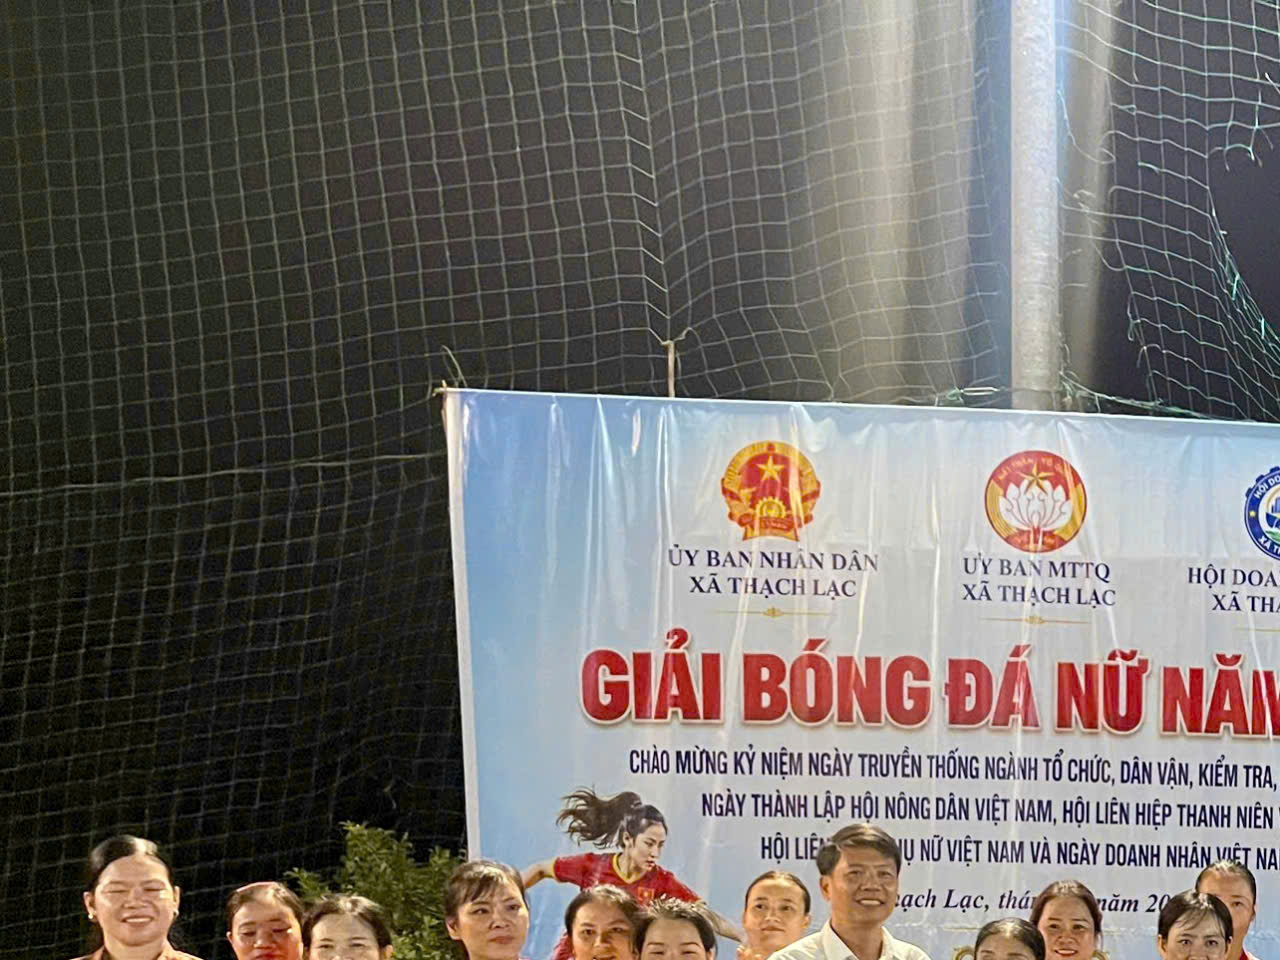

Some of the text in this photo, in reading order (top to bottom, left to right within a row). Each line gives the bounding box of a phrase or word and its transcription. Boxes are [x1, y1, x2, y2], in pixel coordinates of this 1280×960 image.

[668, 544, 879, 572] ỦY BAN NHÂN DÂN
[1000, 558, 1043, 577] BAN
[1049, 560, 1111, 584] MTTQ
[689, 573, 857, 600] XÃ THẠCH LẠC
[1187, 563, 1226, 588] HỘI
[962, 580, 1116, 609] XÃ THẠCH LẠC
[1212, 591, 1242, 612] XÃ
[580, 626, 724, 723] GIẢI
[742, 637, 933, 727] BÓNG
[943, 643, 1041, 729] ĐÁ
[1055, 648, 1151, 734] NỮ
[629, 744, 670, 774] CHÀO
[675, 745, 728, 775] MỪNG
[733, 743, 756, 775] KỶ
[761, 746, 803, 780] NIỆM
[808, 747, 853, 777] NGÀY
[858, 746, 922, 779] TRUYỀN
[927, 747, 980, 780] THỐNG
[985, 751, 1038, 781] NGÀNH
[1042, 748, 1064, 782] TỔ
[1067, 754, 1116, 786] CHỨC,
[1120, 756, 1152, 785] DÂN
[1158, 757, 1193, 789] VẬN,
[1199, 754, 1238, 787] KIỂM
[1243, 764, 1277, 792] TRA,
[702, 788, 746, 817] NGÀY
[751, 789, 808, 818] THÀNH
[814, 790, 845, 823] LẬP
[851, 791, 879, 823] HỘI
[885, 791, 931, 820] NÔNG
[935, 792, 969, 821] DÂN
[975, 793, 1010, 826] VIỆT
[1015, 798, 1057, 825] NAM,
[1063, 795, 1090, 828] HỘI
[1096, 797, 1130, 825] LIÊN
[1135, 798, 1172, 831] HIỆP
[1177, 803, 1231, 828] THANH
[1236, 801, 1273, 829] NIÊN
[761, 832, 789, 864] HỘI
[920, 834, 944, 862] NỮ
[947, 834, 982, 867] VIỆT
[988, 840, 1025, 864] NAM
[1030, 836, 1051, 864] VÀ
[1057, 838, 1100, 866] NGÀY
[1105, 843, 1160, 867] DOANH
[1166, 841, 1211, 868] NHÂN
[895, 888, 1037, 913] ạch Lạc, thá
[1097, 893, 1171, 912] năm 20
